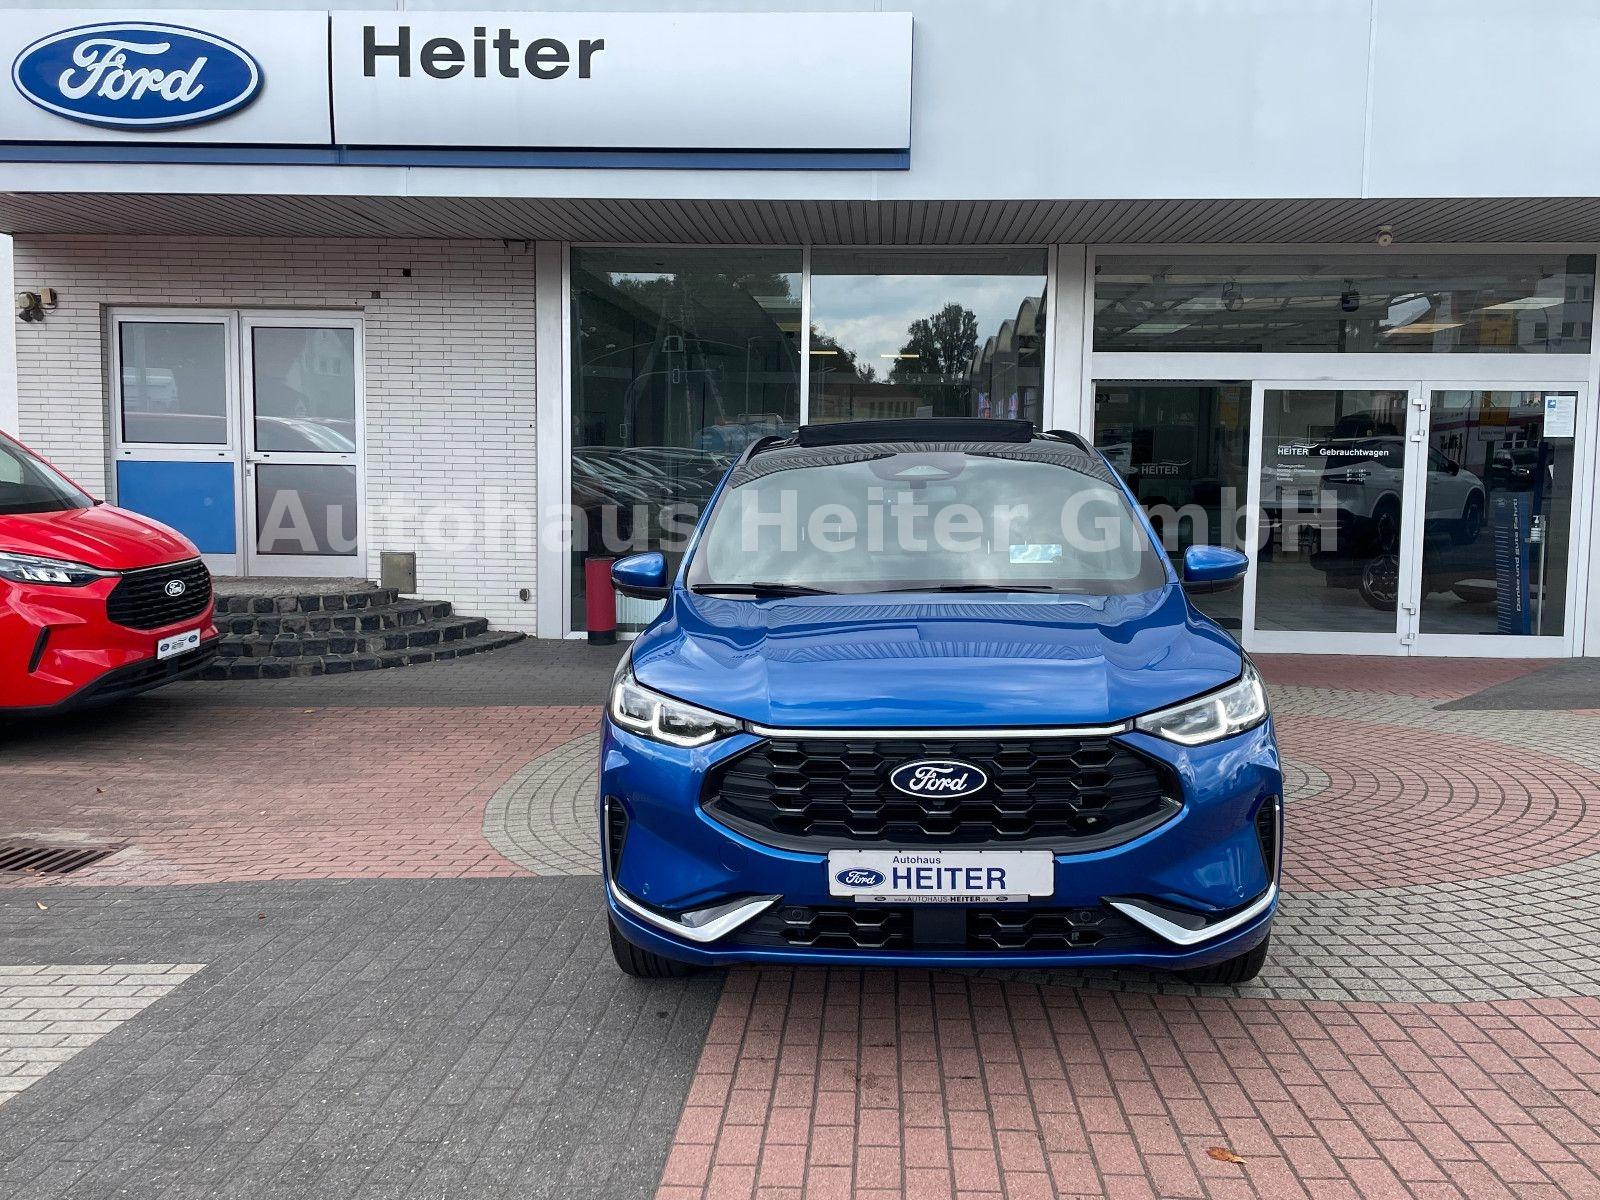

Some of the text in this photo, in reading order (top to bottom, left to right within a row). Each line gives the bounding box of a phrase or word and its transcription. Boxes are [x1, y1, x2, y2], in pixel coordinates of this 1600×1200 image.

[362, 25, 605, 80] Heiter
[58, 37, 208, 103] Ford
[1277, 447, 1390, 458] HEITER Gebrauchtwagen
[1141, 465, 1179, 475] HEITER
[909, 766, 968, 792] Ford
[892, 855, 942, 865] Autohaus
[845, 869, 876, 885] Ford
[892, 867, 1007, 890] HEITER
